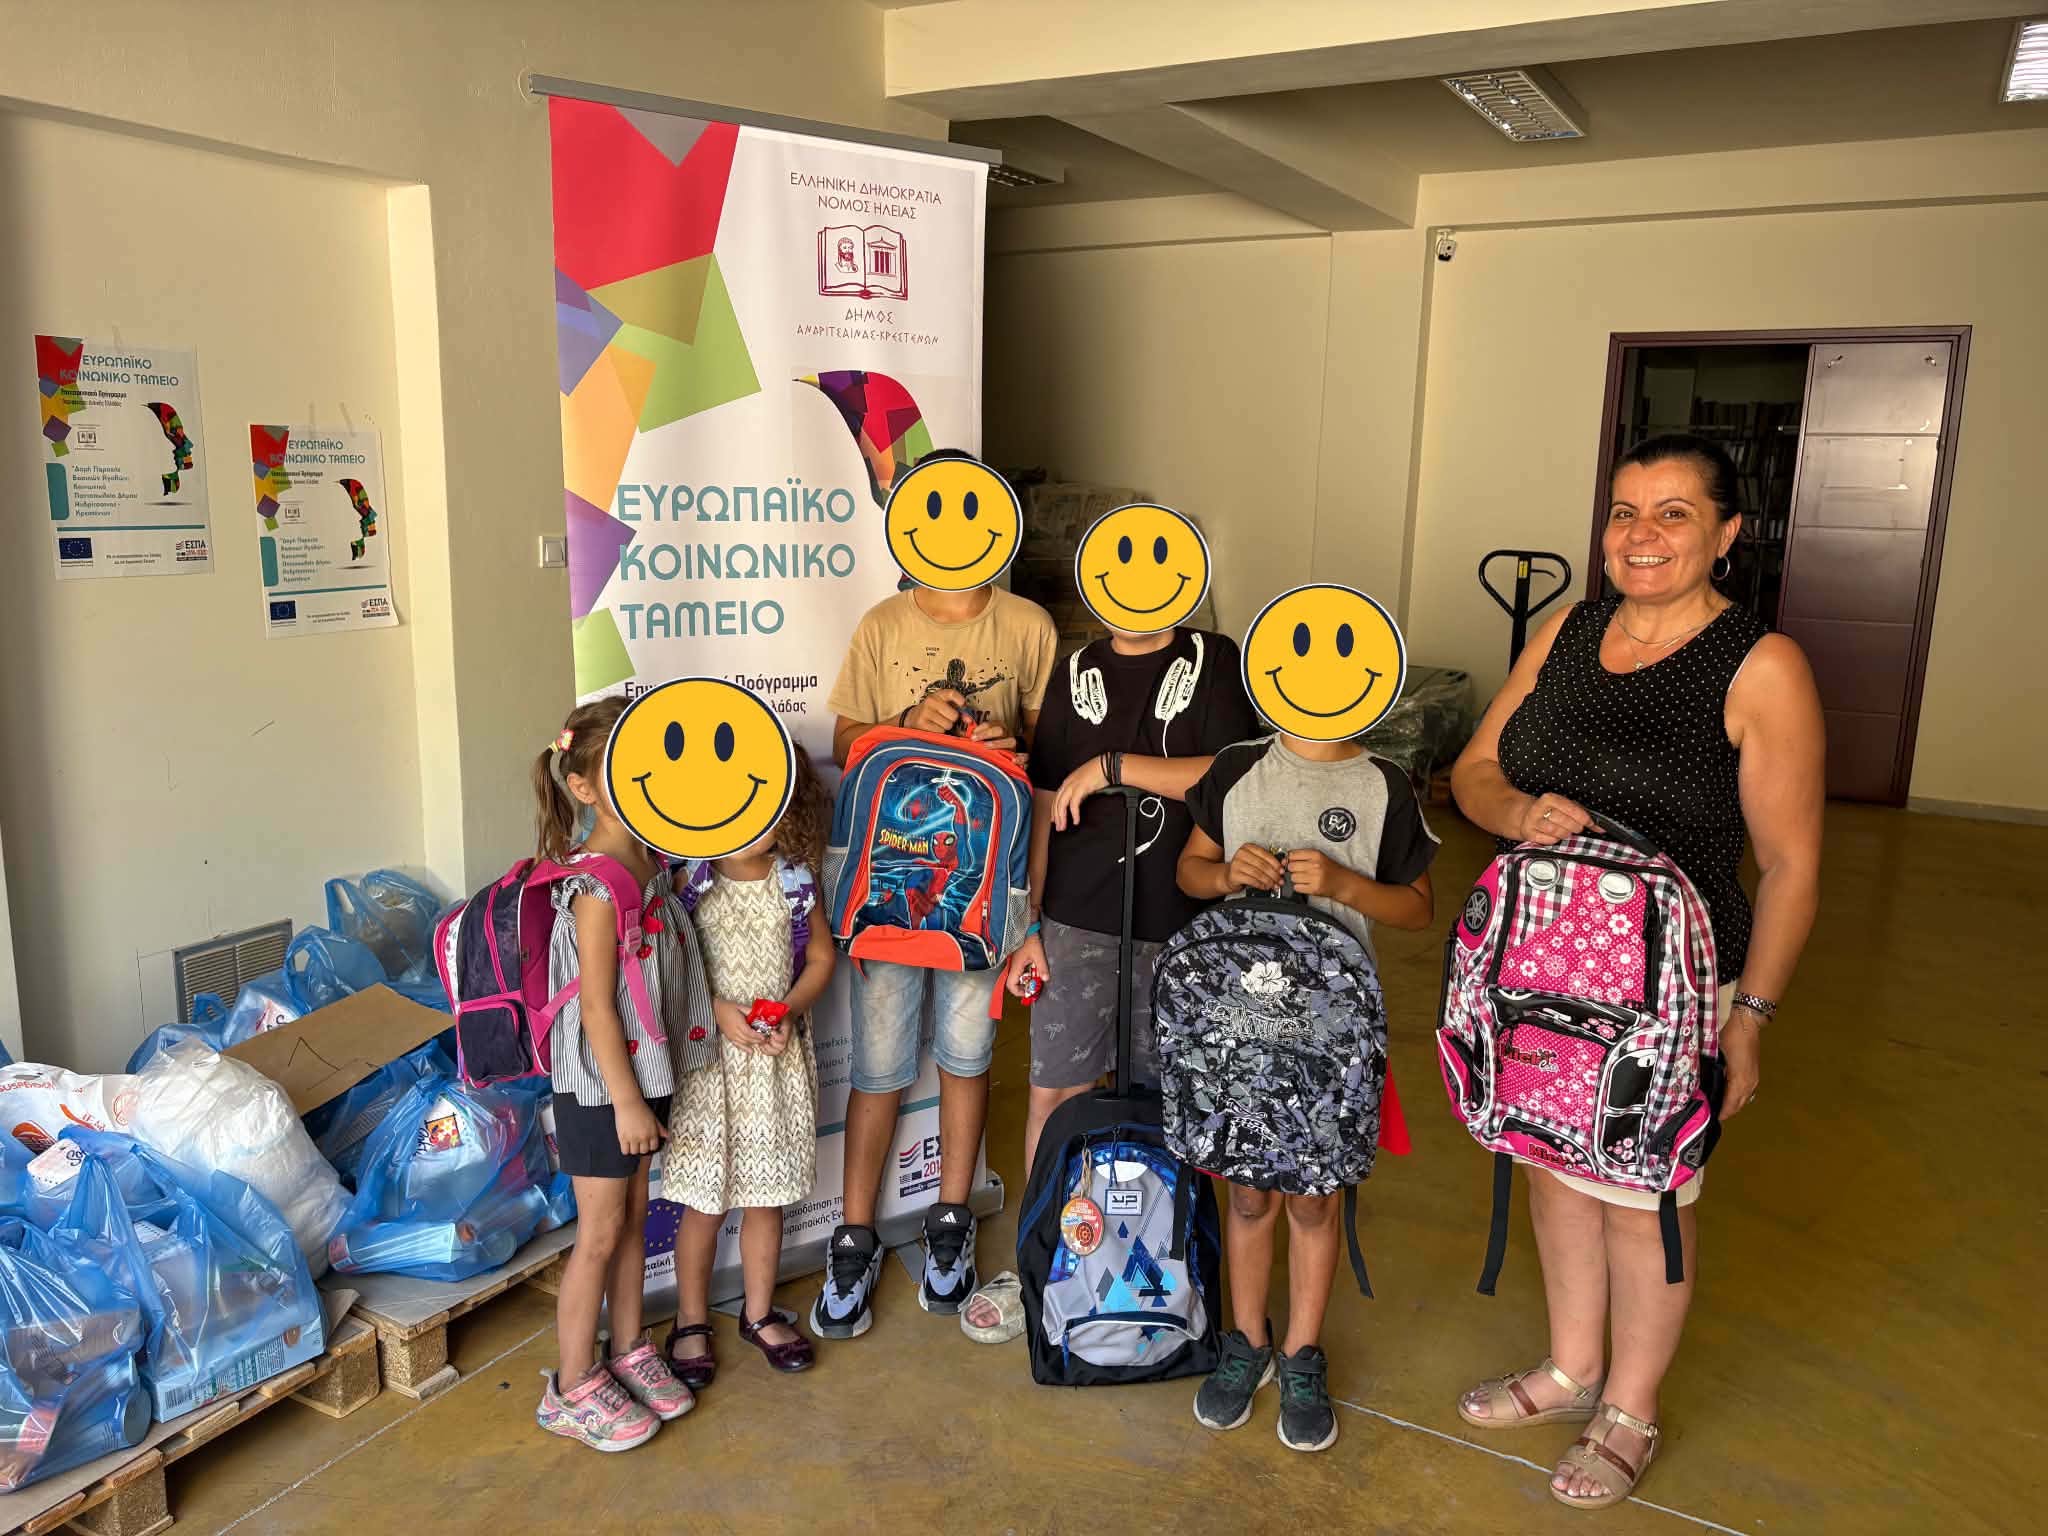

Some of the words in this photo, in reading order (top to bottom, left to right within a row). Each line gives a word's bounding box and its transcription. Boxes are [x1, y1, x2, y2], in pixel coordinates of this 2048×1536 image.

[790, 172, 856, 193] ΕΛΛΗΝΙΚΗ
[859, 183, 942, 205] ΔΗΜΟΚΡΑΤΙΑ
[818, 195, 870, 213] ΝΟΜΟΣ
[874, 202, 917, 220] ΗΛΕΙΑΣ
[845, 307, 895, 325] ΔΗΜΟΣ
[82, 354, 153, 370] ΕΥΡΩΠΑΪΚΟ
[59, 371, 131, 384] ΚΟΙΝΩΝΙΚΟ
[133, 373, 179, 387] ΤΑΜΕΙΟ
[288, 439, 344, 451] ΕΥΡΩΠΑΪΚΟ
[329, 454, 366, 465] ΤΑΜΕΙΟ
[617, 478, 856, 523] ΕΥΡΩΠΑΪΚΟ
[185, 540, 207, 549] ΕΣΠΑ
[619, 543, 856, 581] ΚΟΙΝΩΝΙΚΟ
[619, 599, 785, 641] ΤΑΜΕΙΟ
[771, 699, 807, 714] λάδας
[879, 828, 929, 856] SPIDER-MAN
